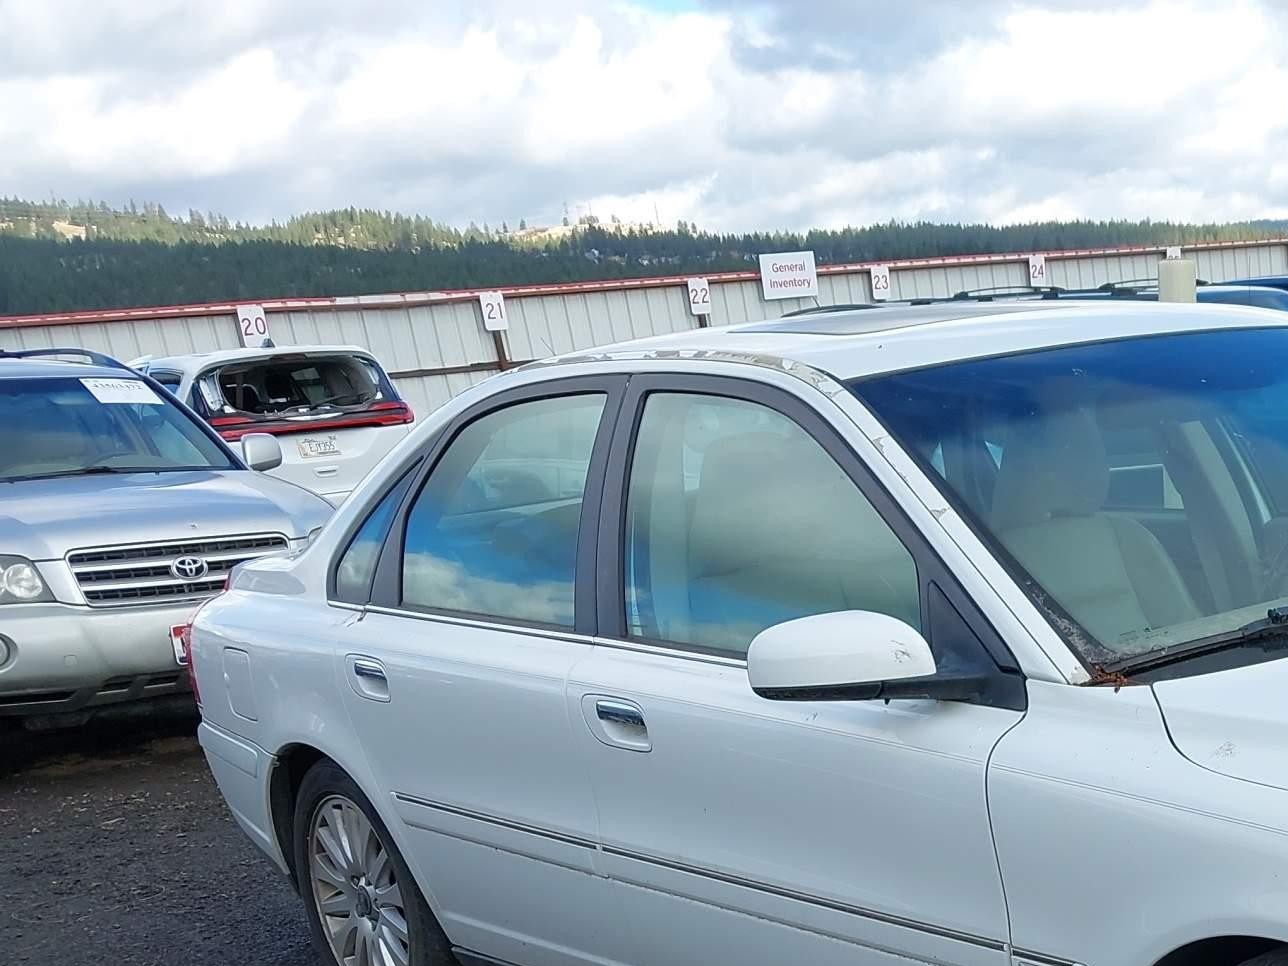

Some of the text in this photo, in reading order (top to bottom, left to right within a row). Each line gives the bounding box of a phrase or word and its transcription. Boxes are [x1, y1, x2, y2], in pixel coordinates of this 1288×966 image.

[771, 261, 806, 273] General
[1031, 264, 1045, 279] 24
[769, 277, 812, 289] Inventory
[873, 274, 889, 290] 23
[690, 287, 710, 305] 22
[485, 302, 504, 320] 21
[241, 316, 267, 336] 20
